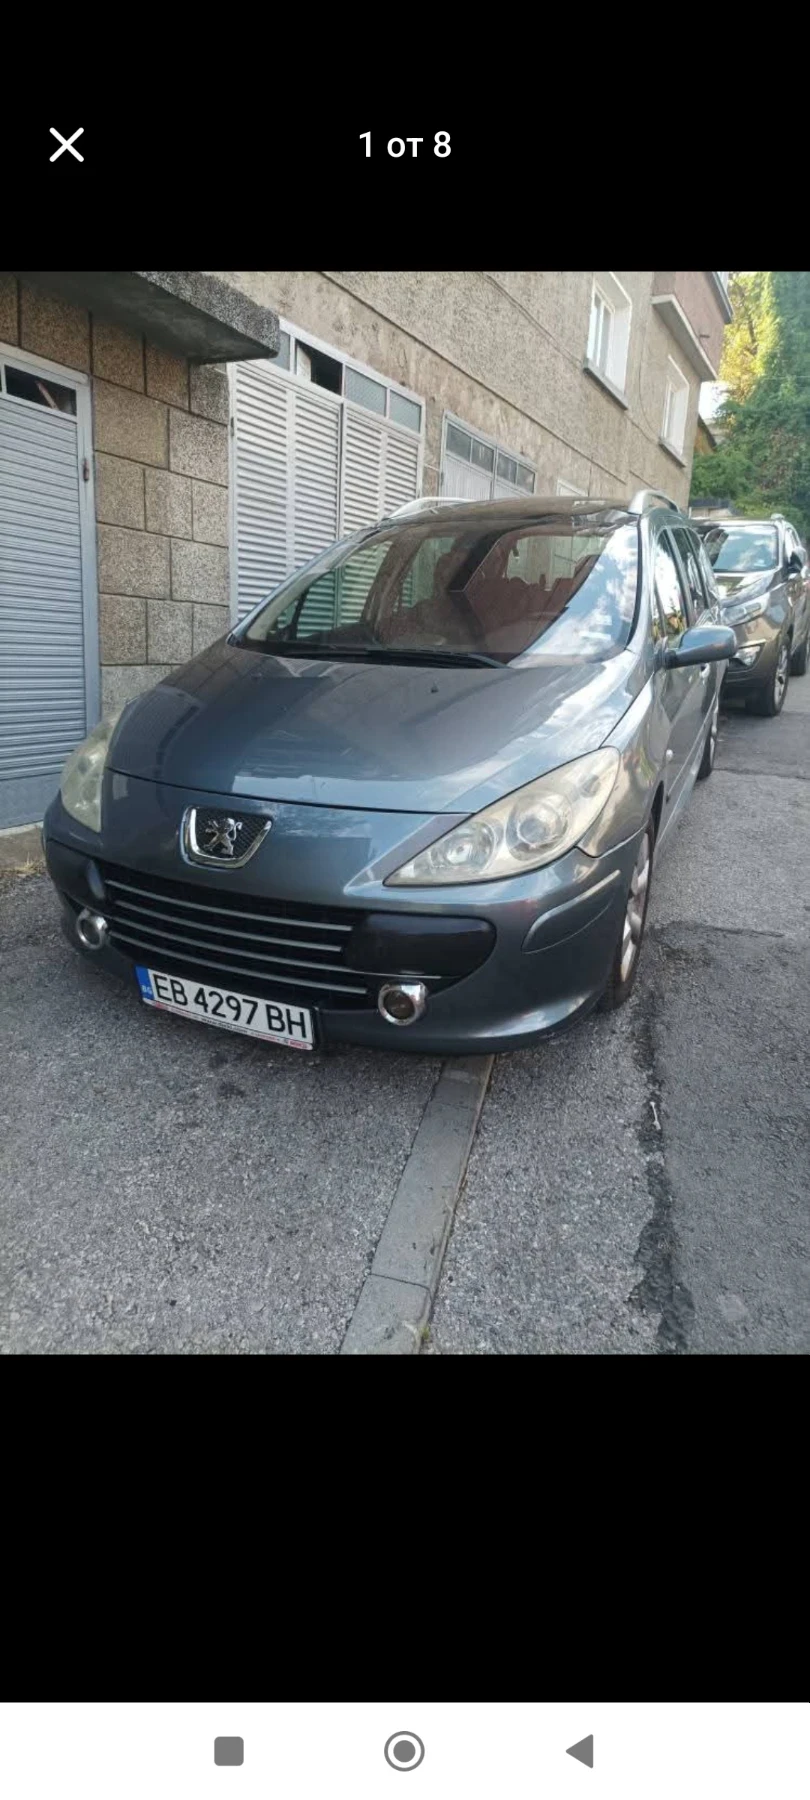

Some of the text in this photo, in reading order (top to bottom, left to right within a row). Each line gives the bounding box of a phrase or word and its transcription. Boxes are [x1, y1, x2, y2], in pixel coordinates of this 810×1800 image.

[153, 973, 188, 1006] EB
[193, 986, 258, 1025] 4297
[265, 1003, 307, 1038] BH
